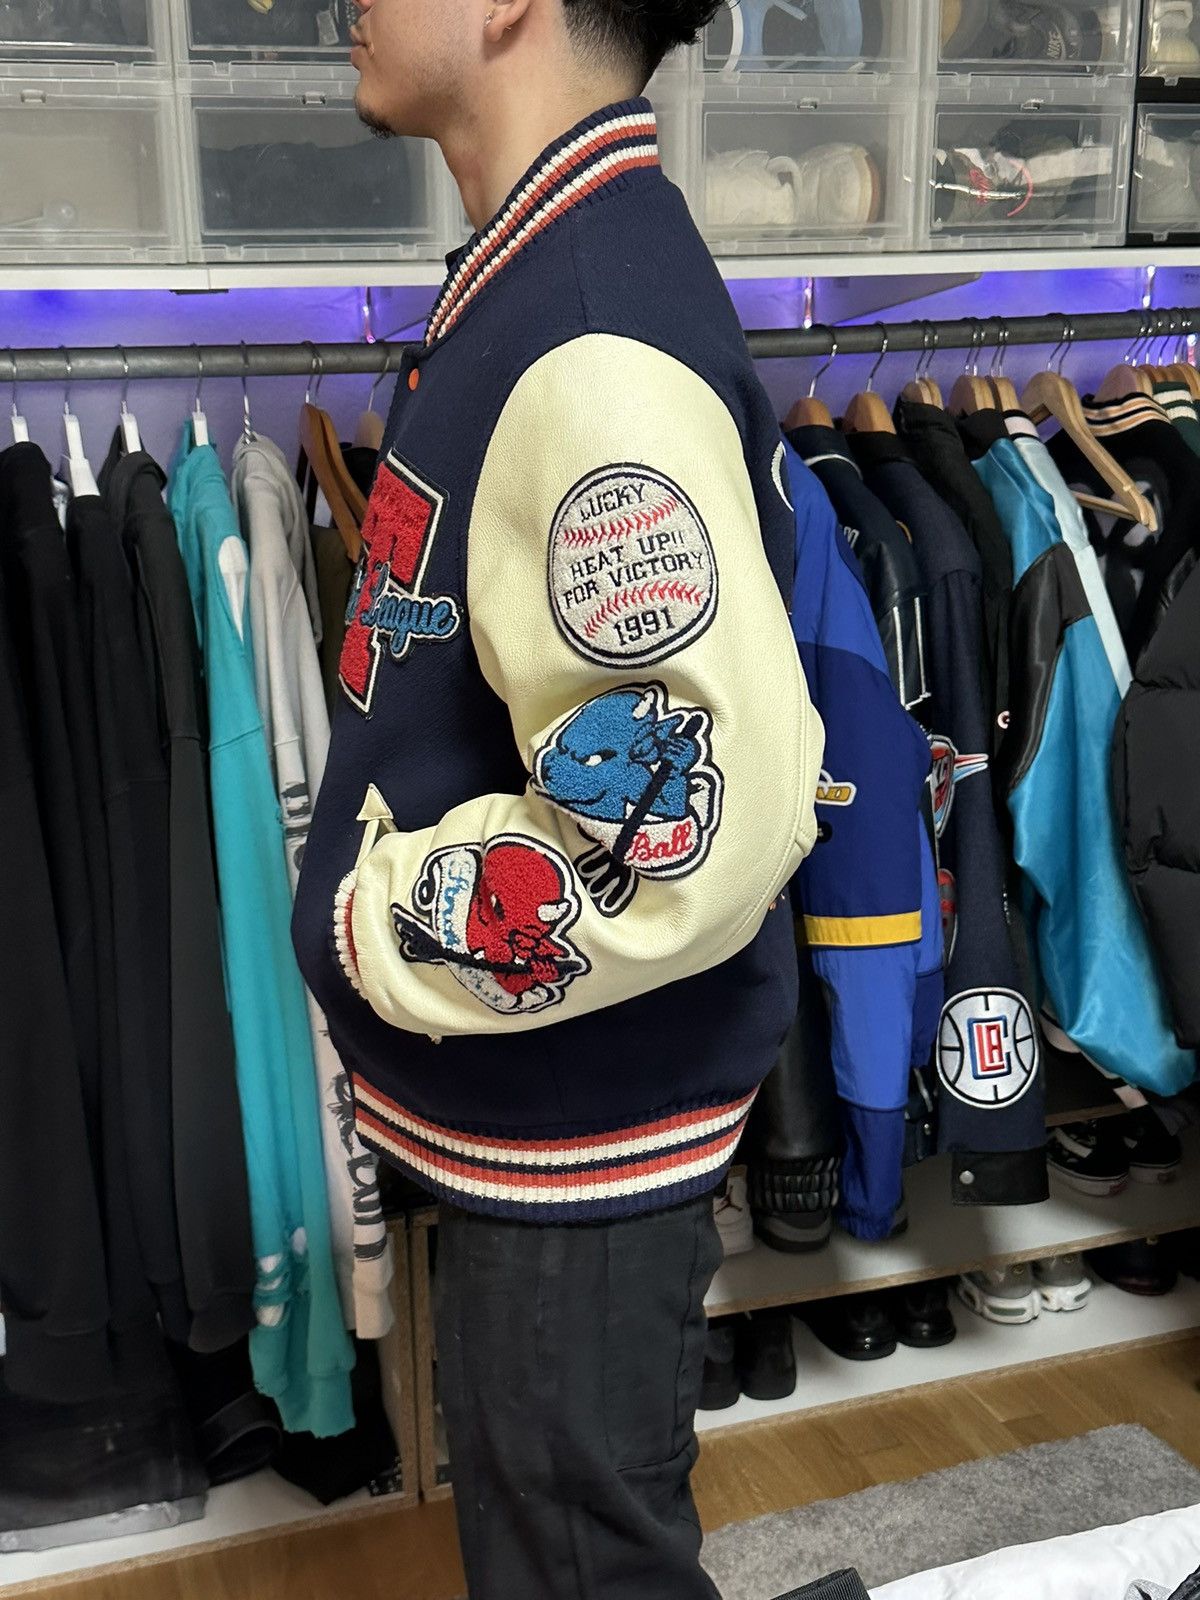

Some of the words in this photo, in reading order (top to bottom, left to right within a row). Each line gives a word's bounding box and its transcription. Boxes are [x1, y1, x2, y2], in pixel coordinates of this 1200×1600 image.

[581, 483, 645, 522] LUCKY
[563, 579, 599, 609] FOR
[608, 552, 703, 587] VICTORY
[570, 545, 624, 580] HEAT
[614, 606, 675, 646] 1991
[627, 820, 694, 861] Ball
